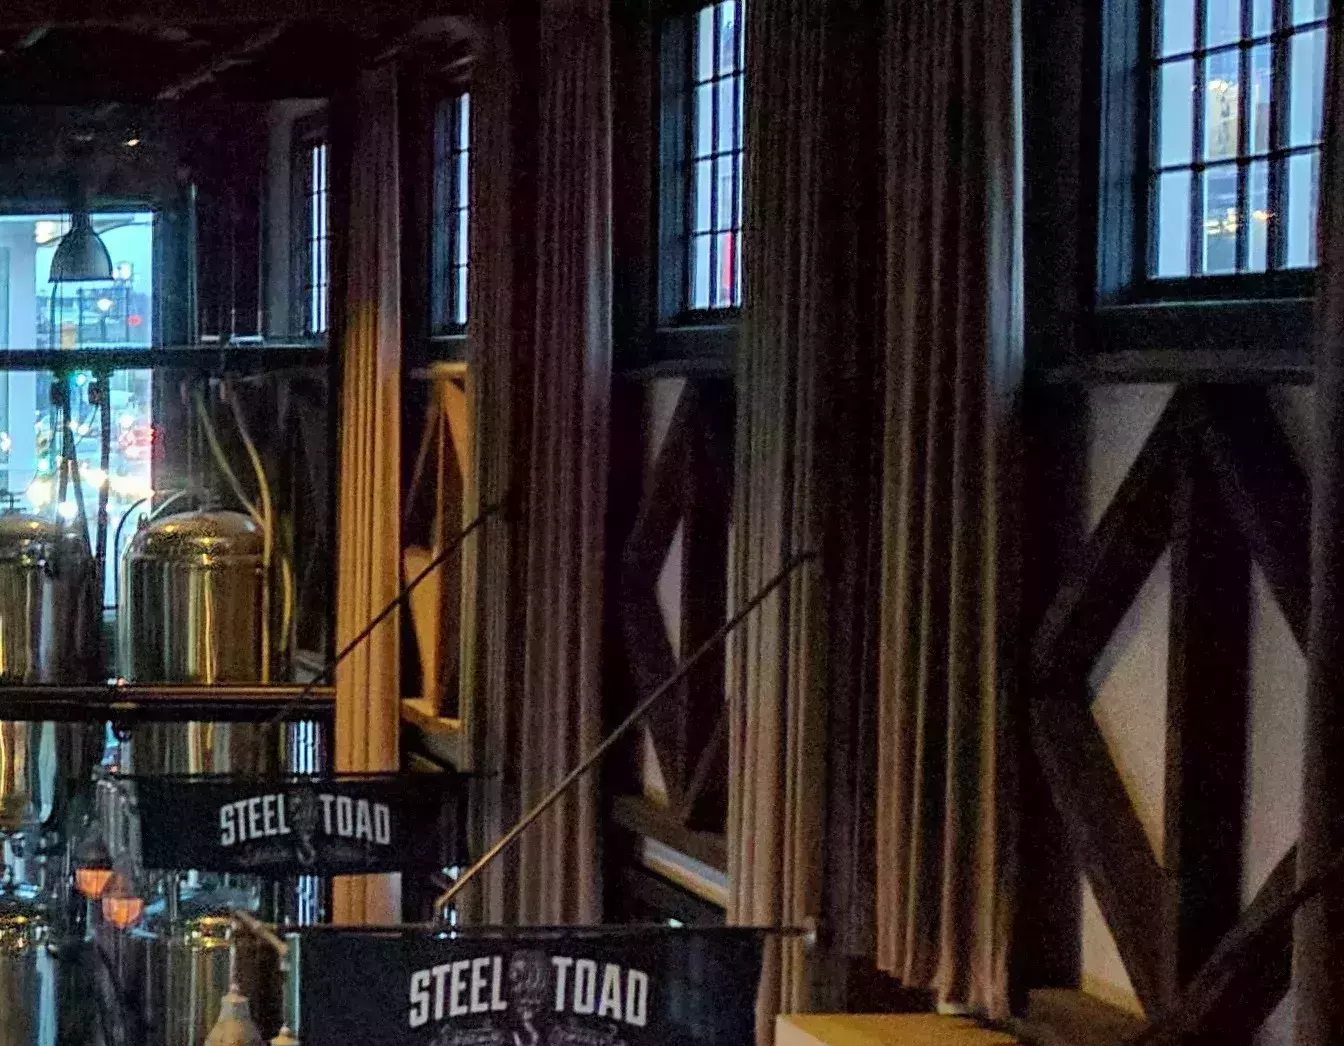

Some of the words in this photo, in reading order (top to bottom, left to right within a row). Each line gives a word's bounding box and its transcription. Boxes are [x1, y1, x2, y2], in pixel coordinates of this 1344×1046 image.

[219, 793, 291, 847] STEEL
[319, 793, 391, 846] TOAD
[409, 955, 509, 1028] STEEL
[551, 955, 648, 1027] TOAD
